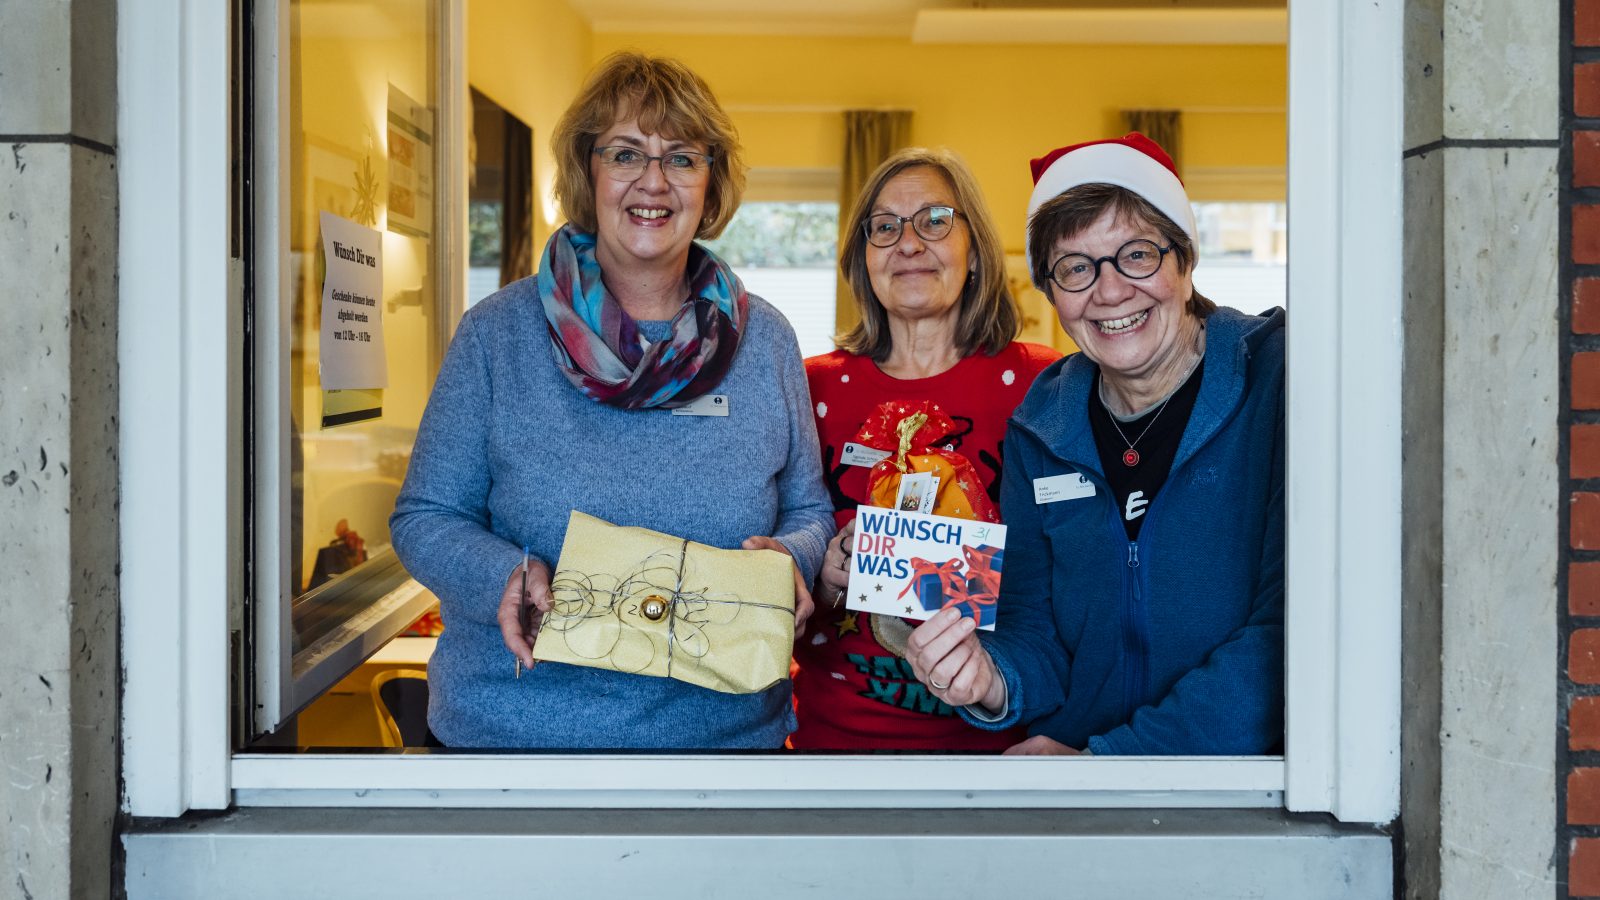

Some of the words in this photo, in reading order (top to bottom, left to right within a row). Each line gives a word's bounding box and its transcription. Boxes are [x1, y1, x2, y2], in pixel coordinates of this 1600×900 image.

[333, 241, 356, 263] Wünsch
[356, 248, 365, 265] Dir
[365, 255, 376, 268] was
[331, 289, 352, 303] Geschenke
[352, 293, 365, 305] können
[338, 308, 354, 323] abgeholt
[354, 312, 369, 323] werden
[334, 331, 342, 340] von
[348, 330, 356, 341] Uhr
[862, 511, 962, 546] WÜNSCH
[858, 533, 896, 557] DIR
[857, 554, 909, 579] WAS
